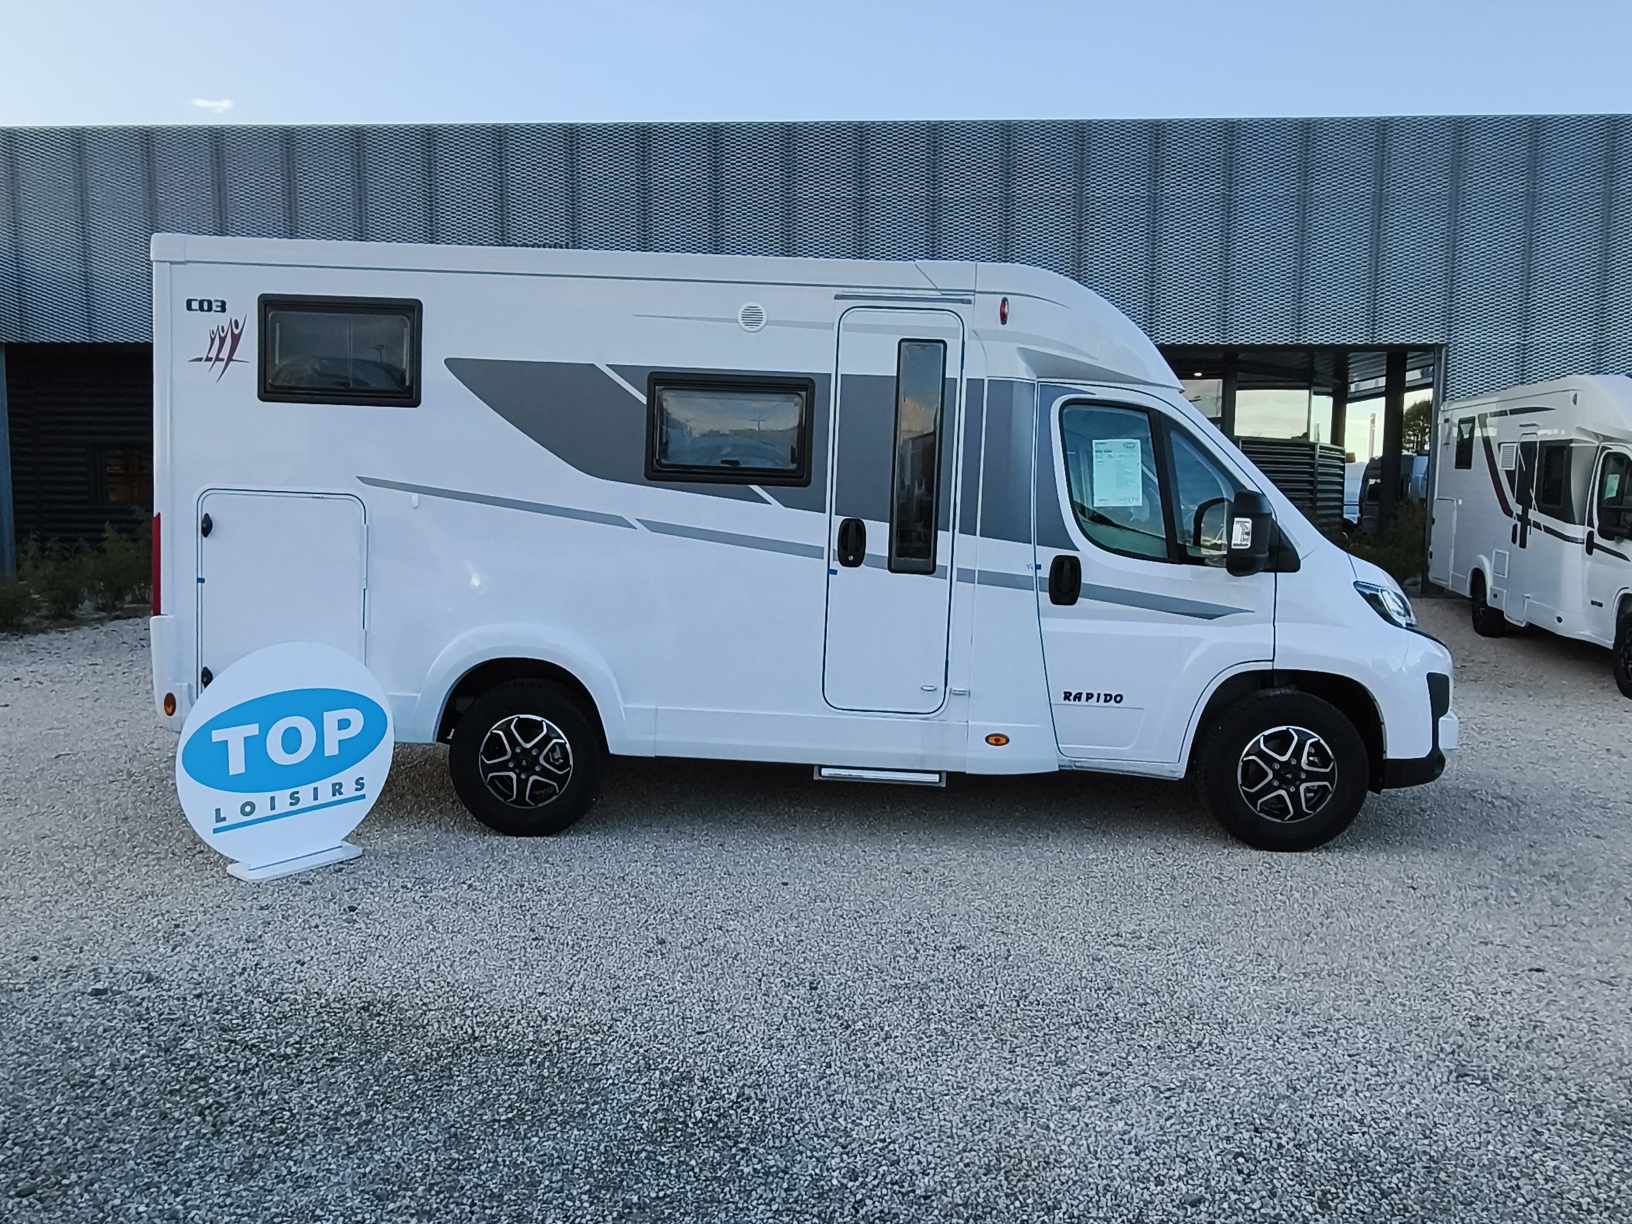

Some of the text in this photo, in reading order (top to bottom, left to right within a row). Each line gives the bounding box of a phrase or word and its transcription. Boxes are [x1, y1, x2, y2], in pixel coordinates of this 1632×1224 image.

[1063, 691, 1124, 704] RAPIDO
[211, 708, 365, 776] TOP
[214, 777, 366, 823] LOISIRS
